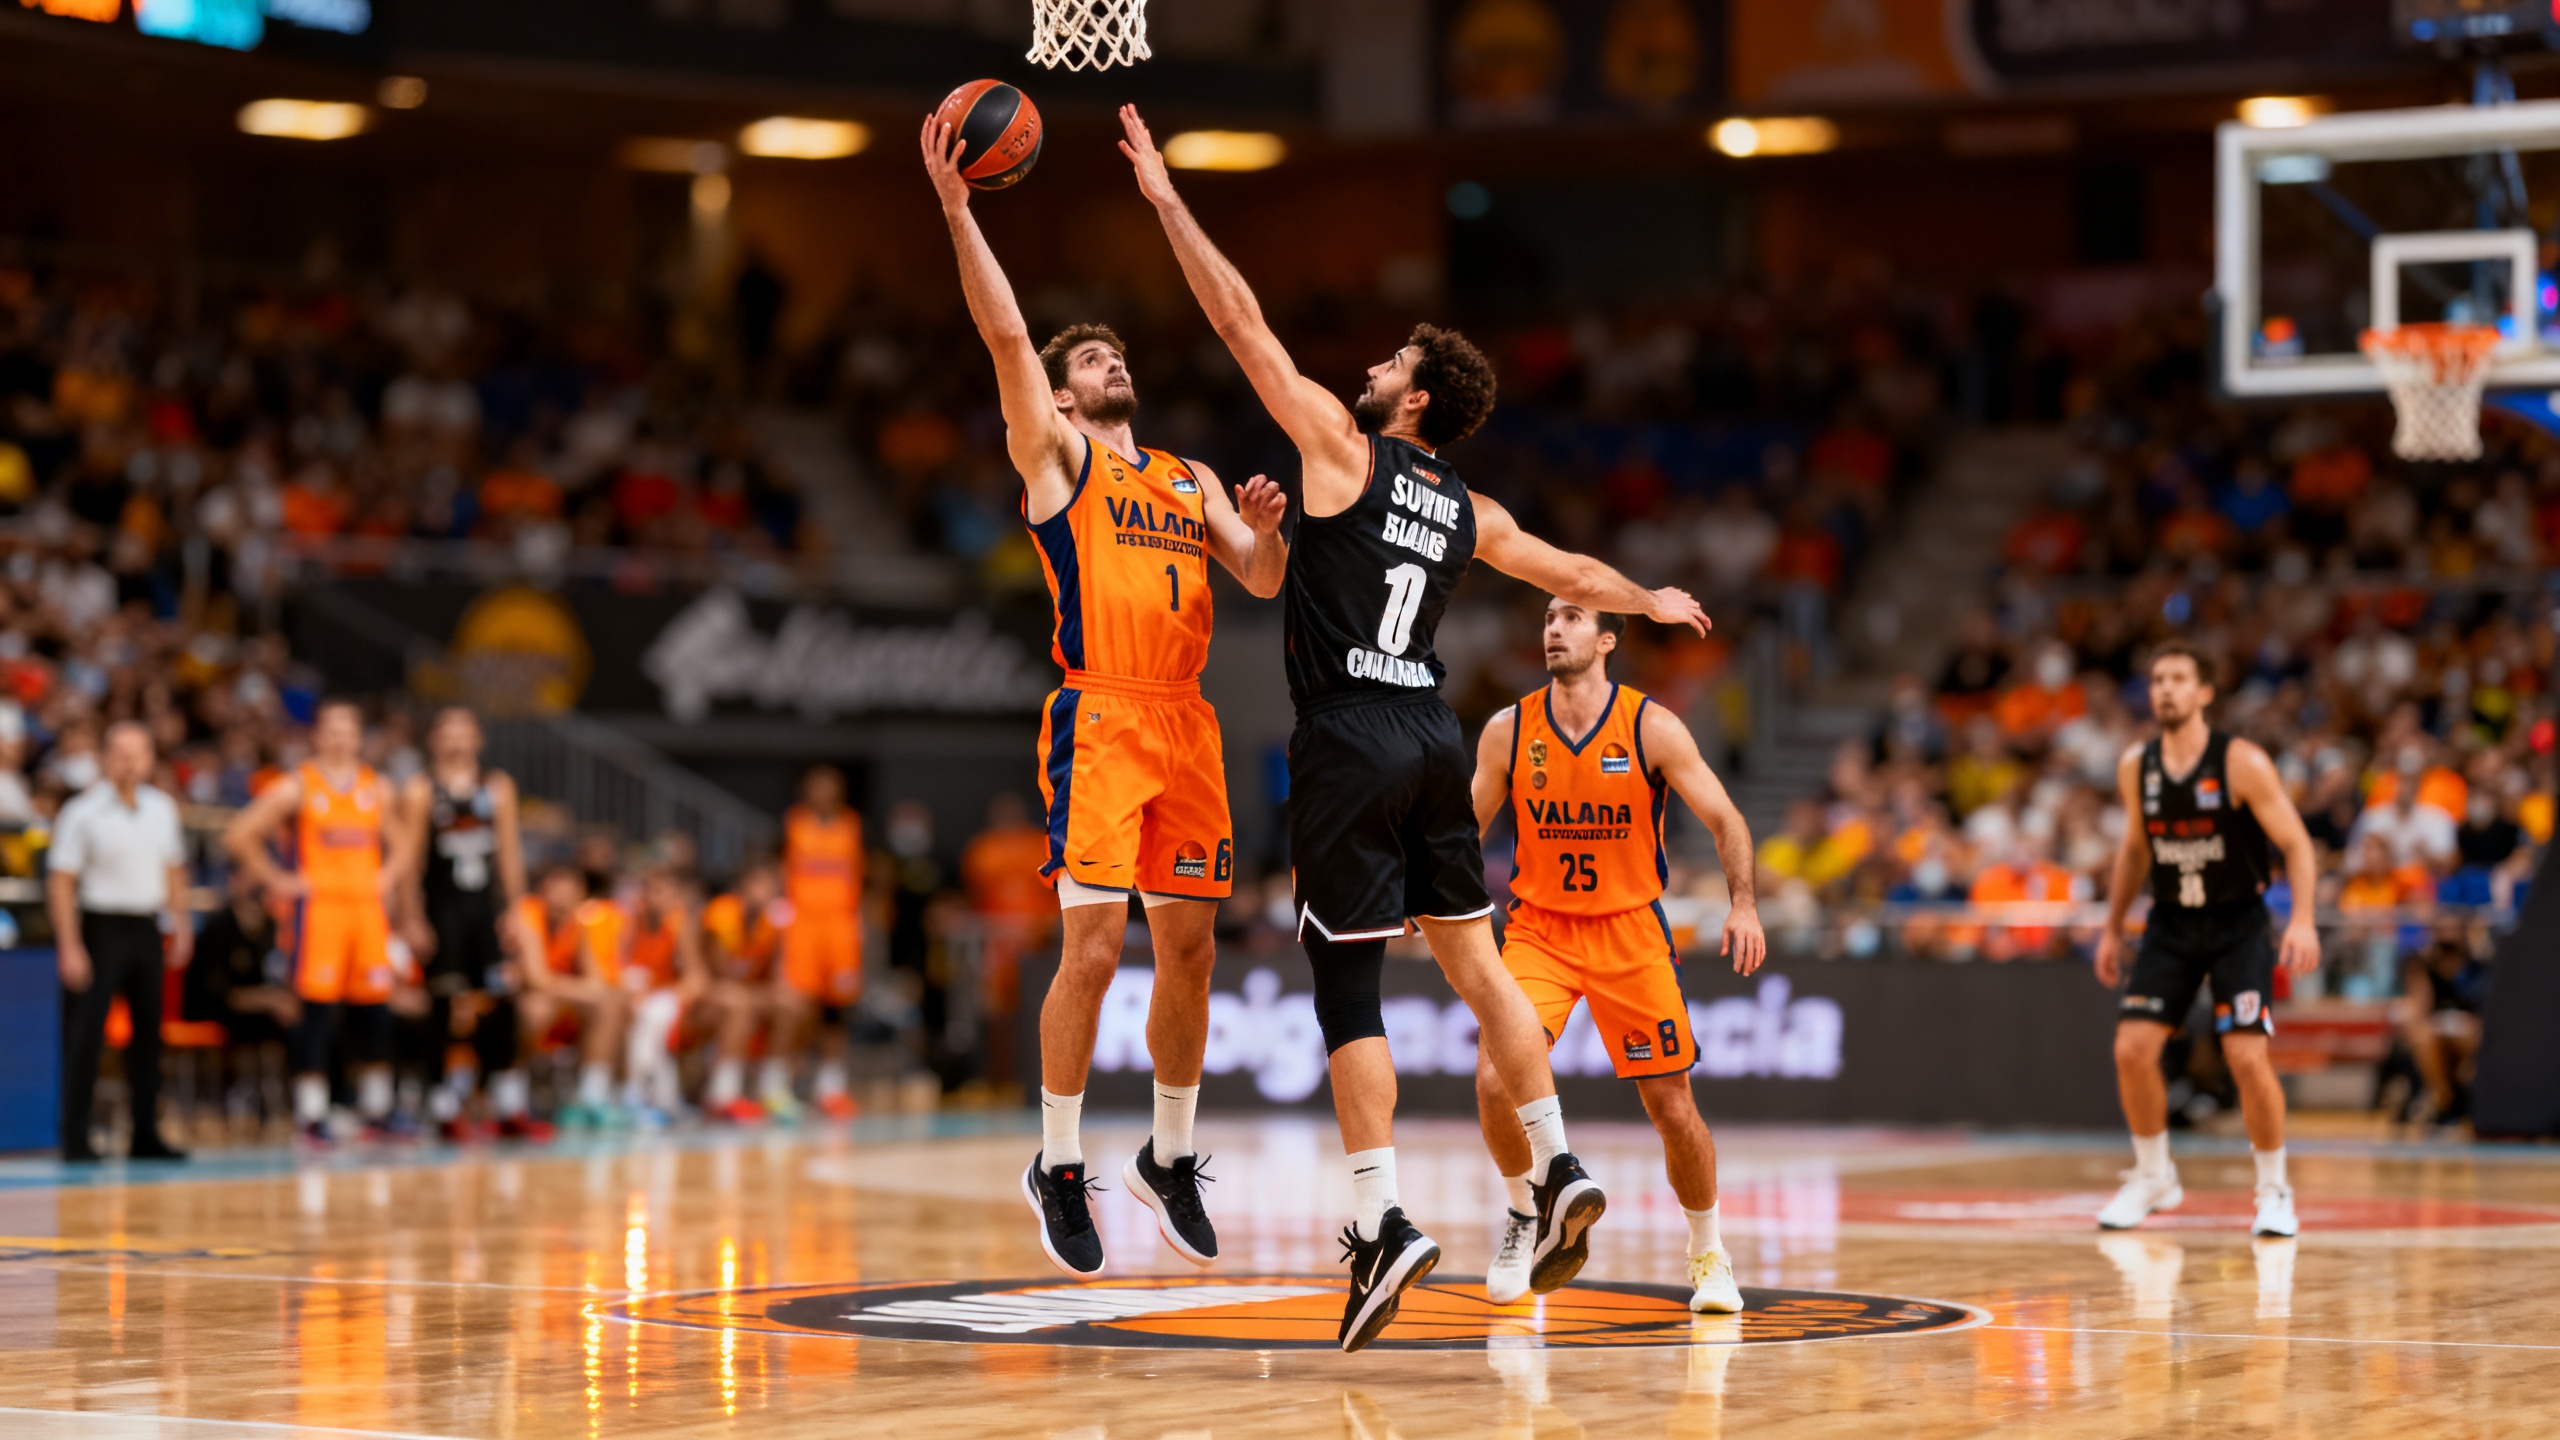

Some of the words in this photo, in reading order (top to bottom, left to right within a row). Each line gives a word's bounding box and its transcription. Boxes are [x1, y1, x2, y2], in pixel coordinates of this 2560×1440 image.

[1166, 564, 1179, 612] 1
[1559, 853, 1598, 892] 25
[1657, 1018, 1680, 1058] 8
